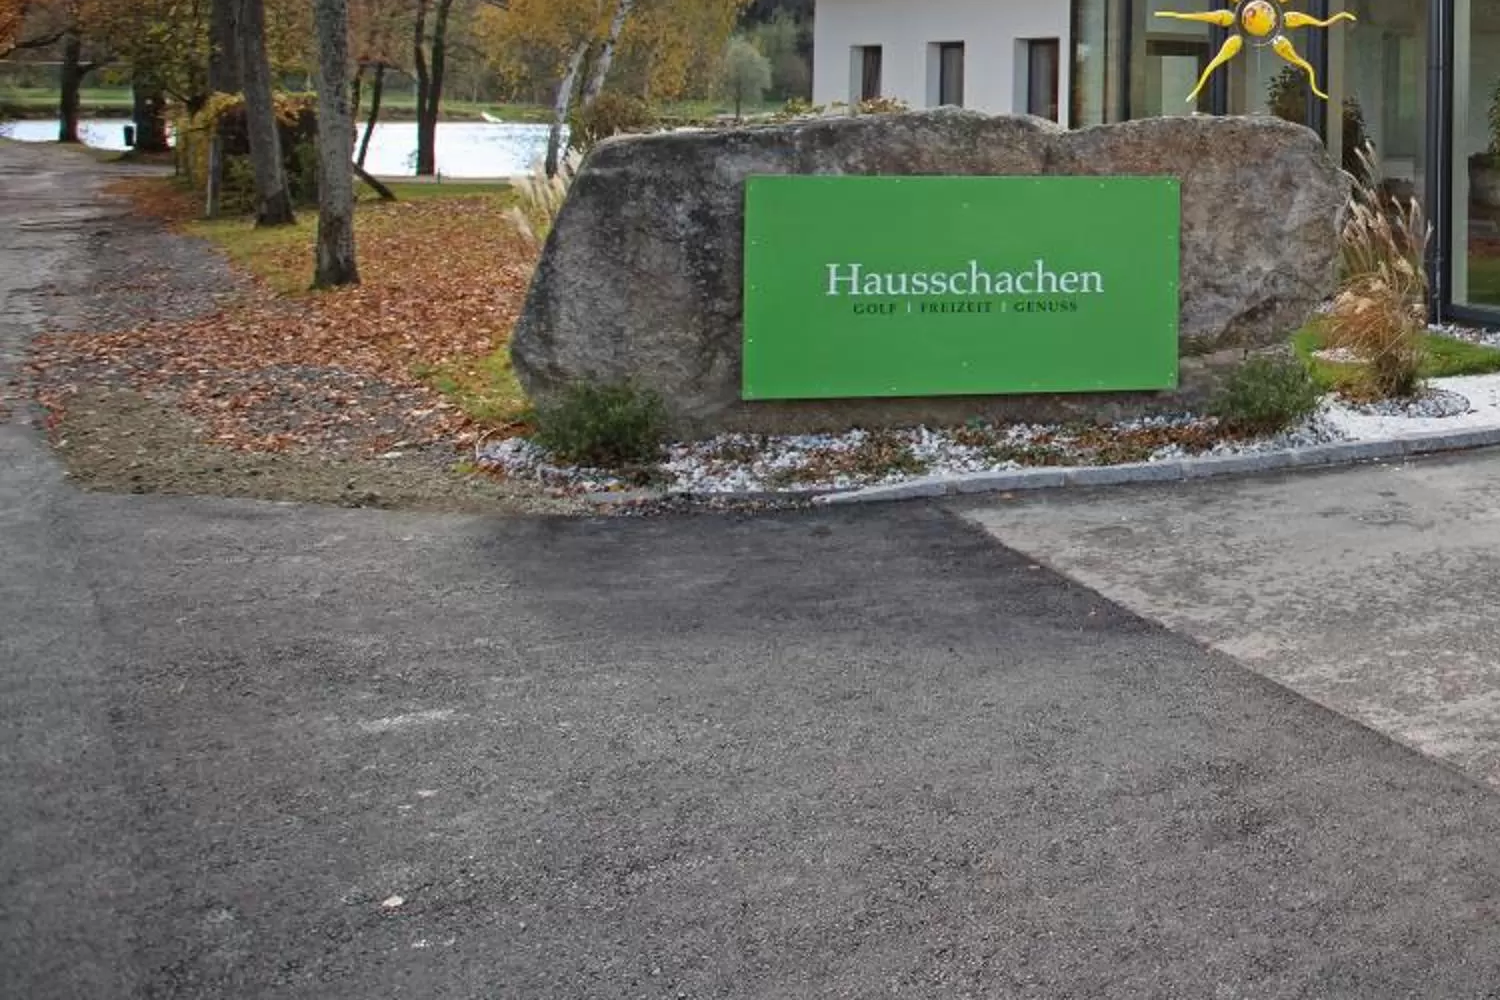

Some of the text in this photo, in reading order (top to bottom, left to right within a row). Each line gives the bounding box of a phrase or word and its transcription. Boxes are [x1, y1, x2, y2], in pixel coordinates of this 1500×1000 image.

[825, 259, 1105, 296] Hausschachen
[853, 300, 1079, 315] GOLF FREIZEIT GENUSS
